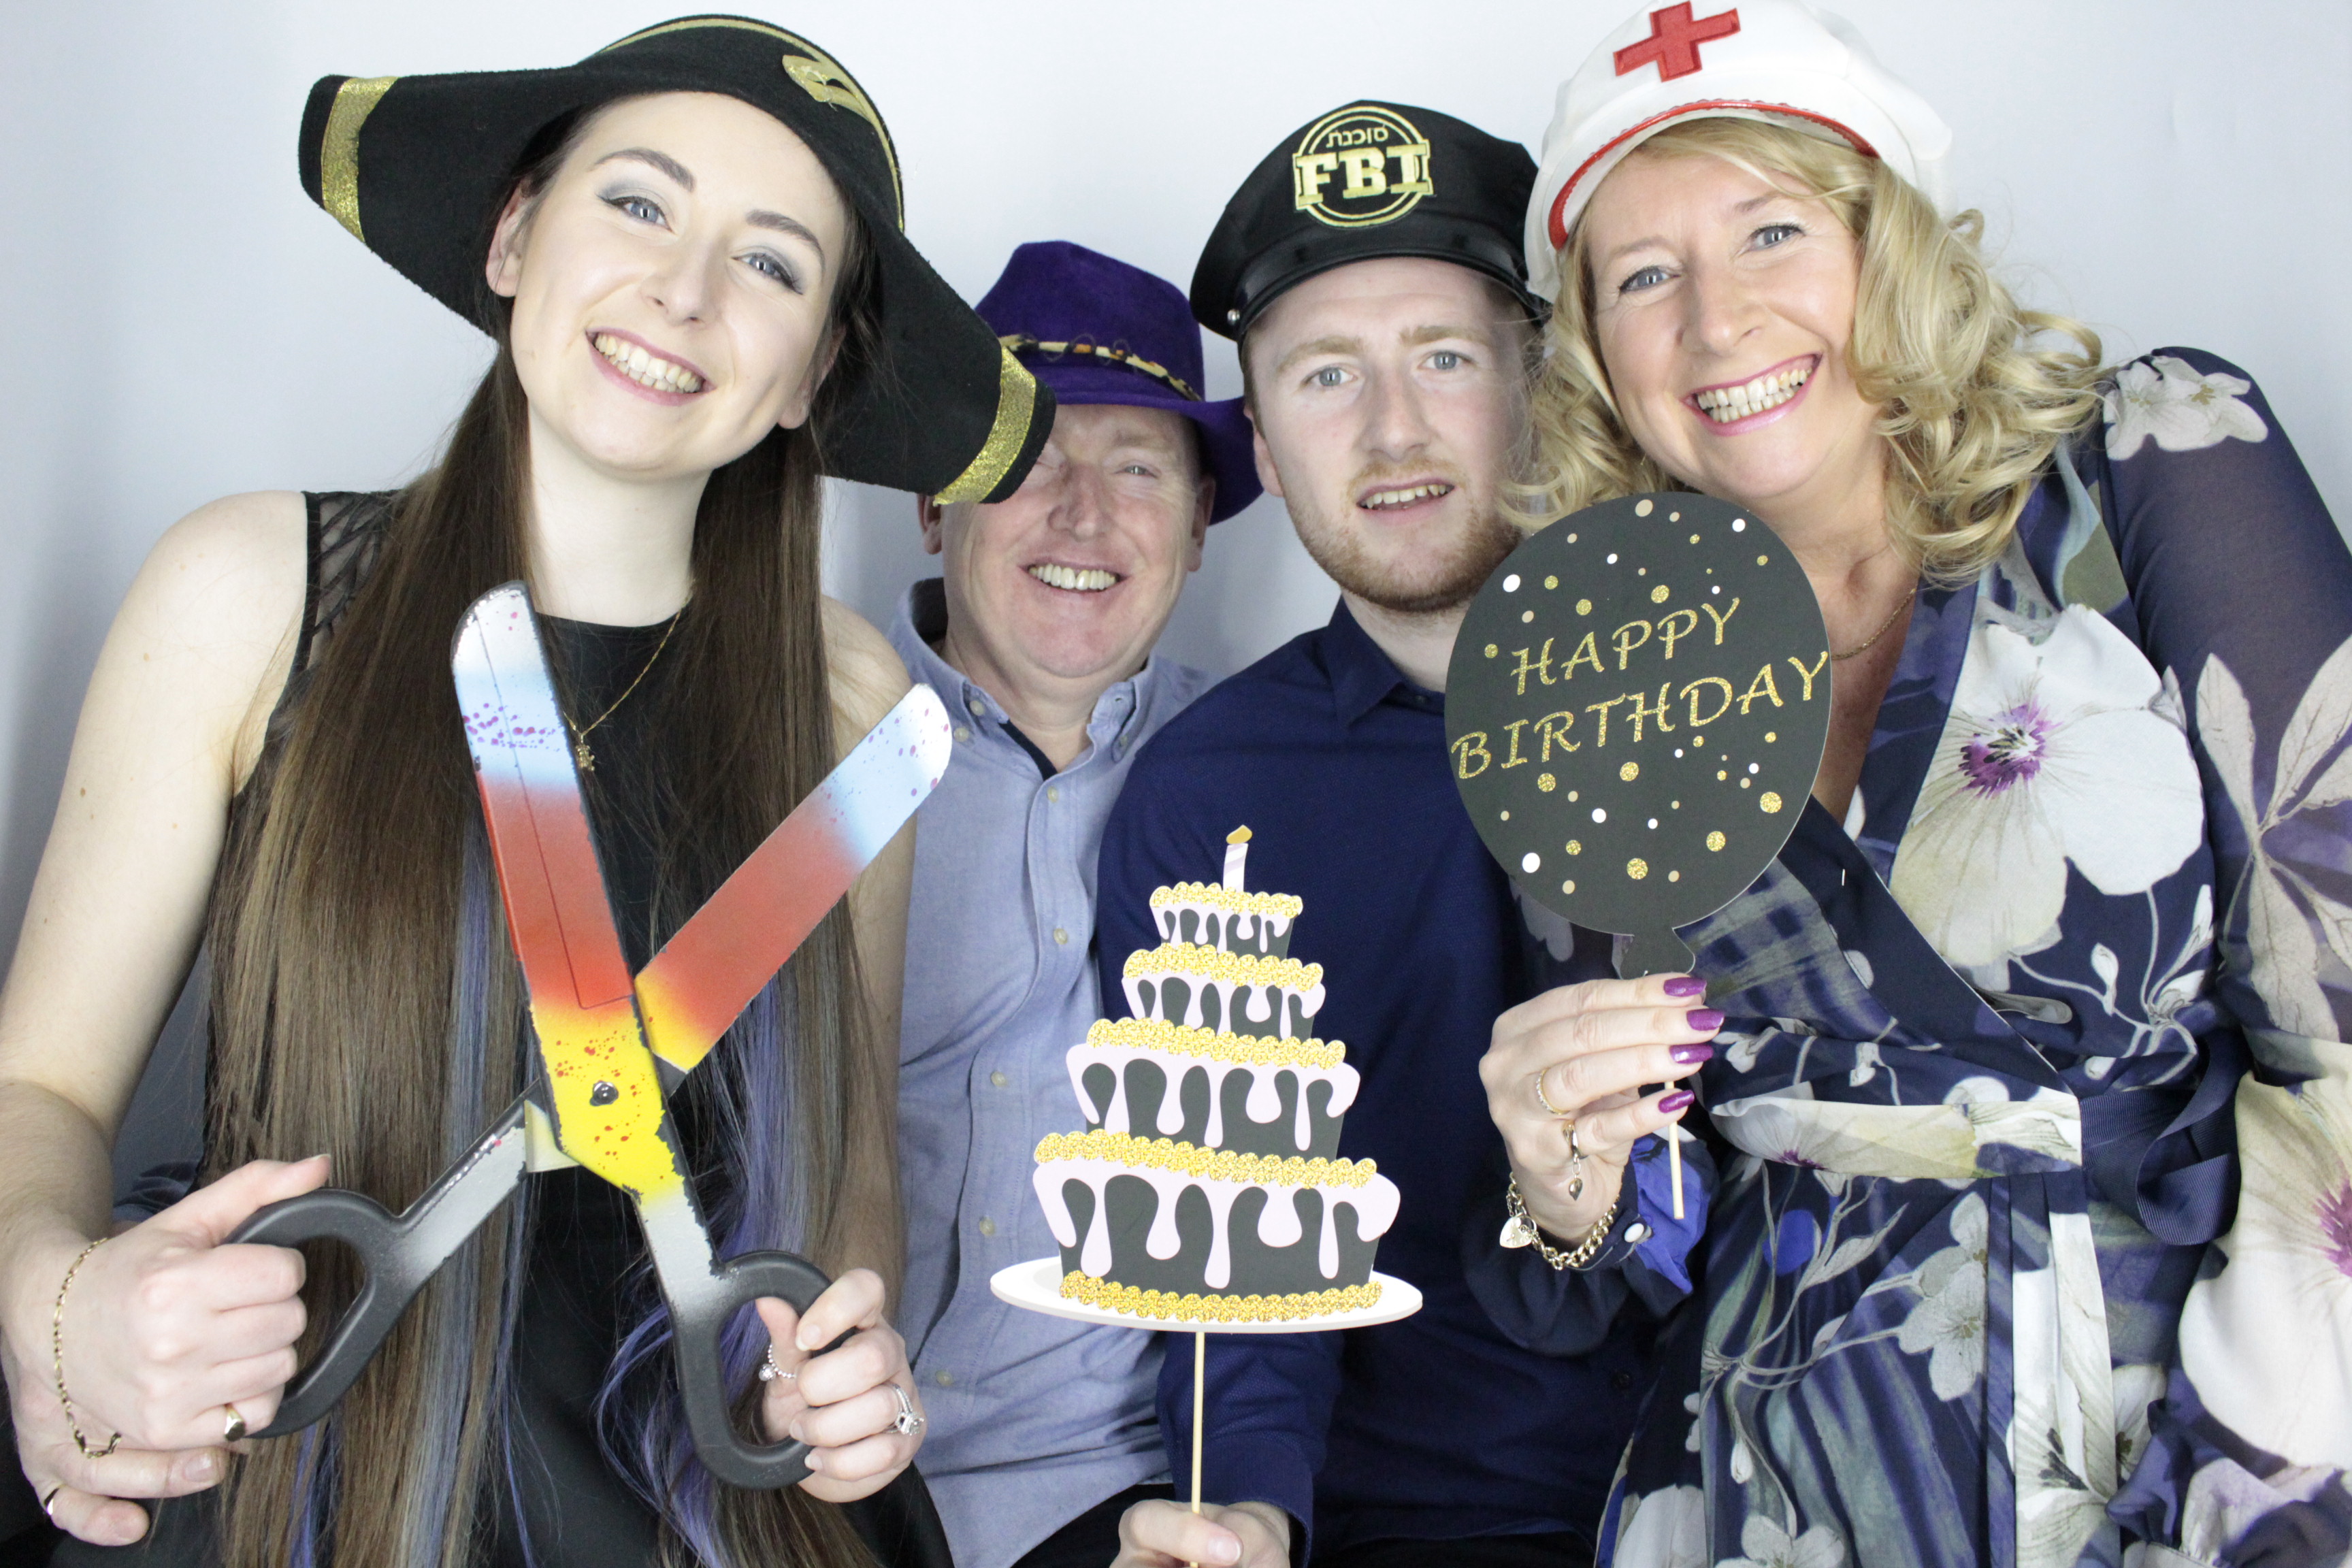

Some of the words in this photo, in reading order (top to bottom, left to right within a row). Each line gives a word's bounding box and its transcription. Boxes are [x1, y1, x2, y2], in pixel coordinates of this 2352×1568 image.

[1294, 142, 1432, 208] FBI
[1326, 127, 1388, 148] סוכנת
[1510, 598, 1740, 695] HAPPY
[1451, 651, 1828, 779] BIRTHDAY
